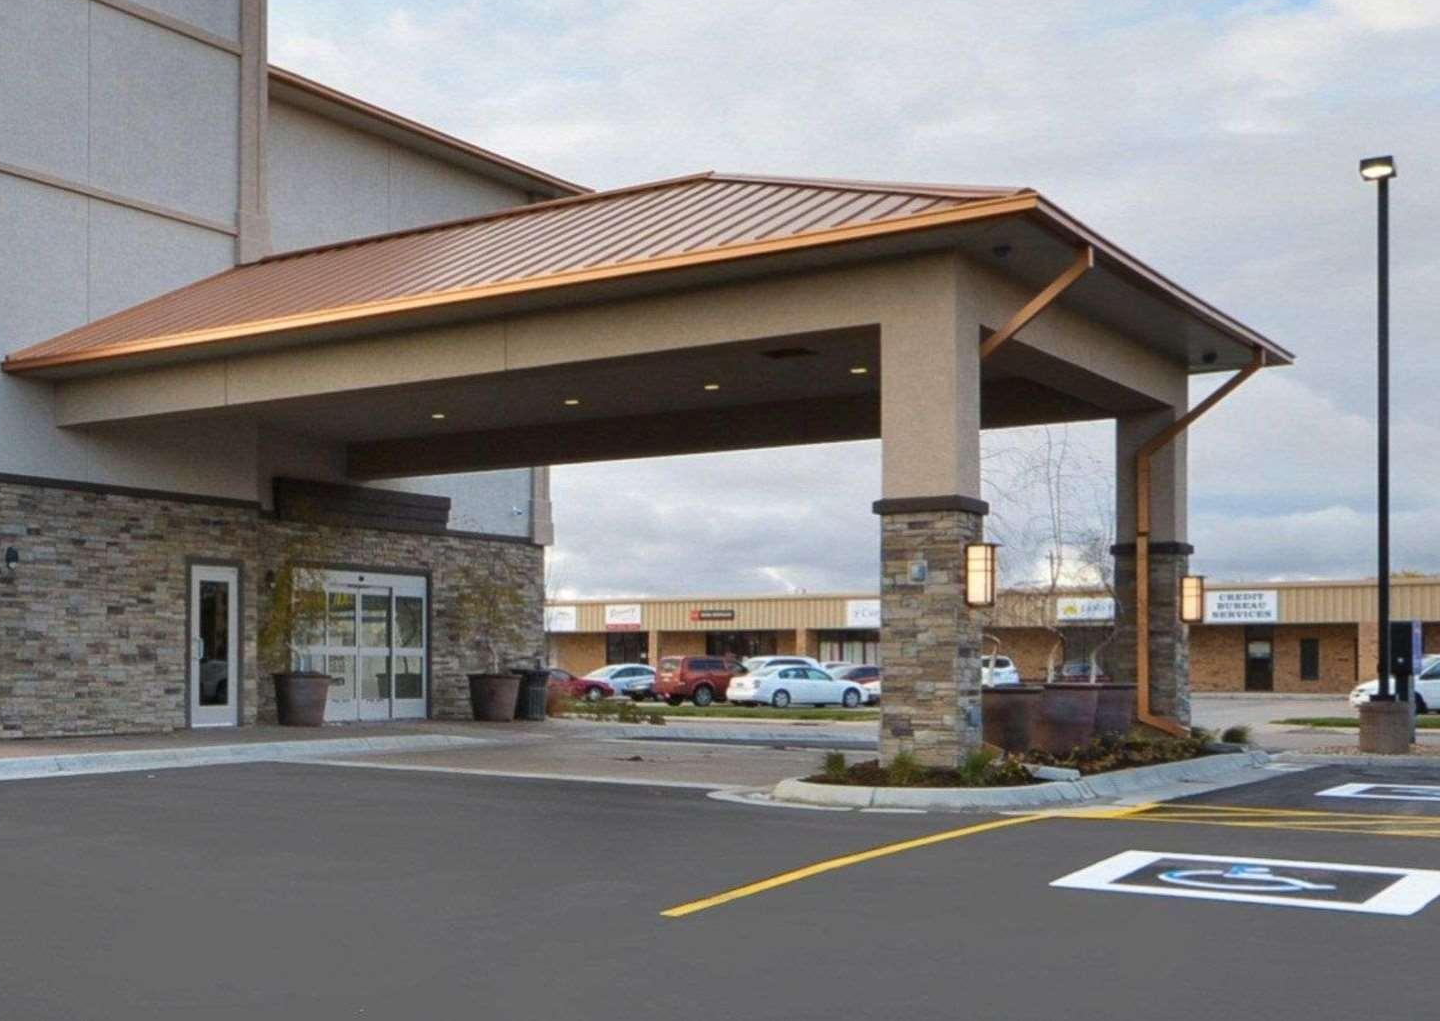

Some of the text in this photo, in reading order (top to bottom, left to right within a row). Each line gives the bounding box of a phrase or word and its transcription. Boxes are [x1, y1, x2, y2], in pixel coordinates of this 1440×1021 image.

[1218, 593, 1264, 601] CREDIT
[1216, 602, 1267, 610] BUREAU
[1211, 610, 1272, 618] SERVICES
